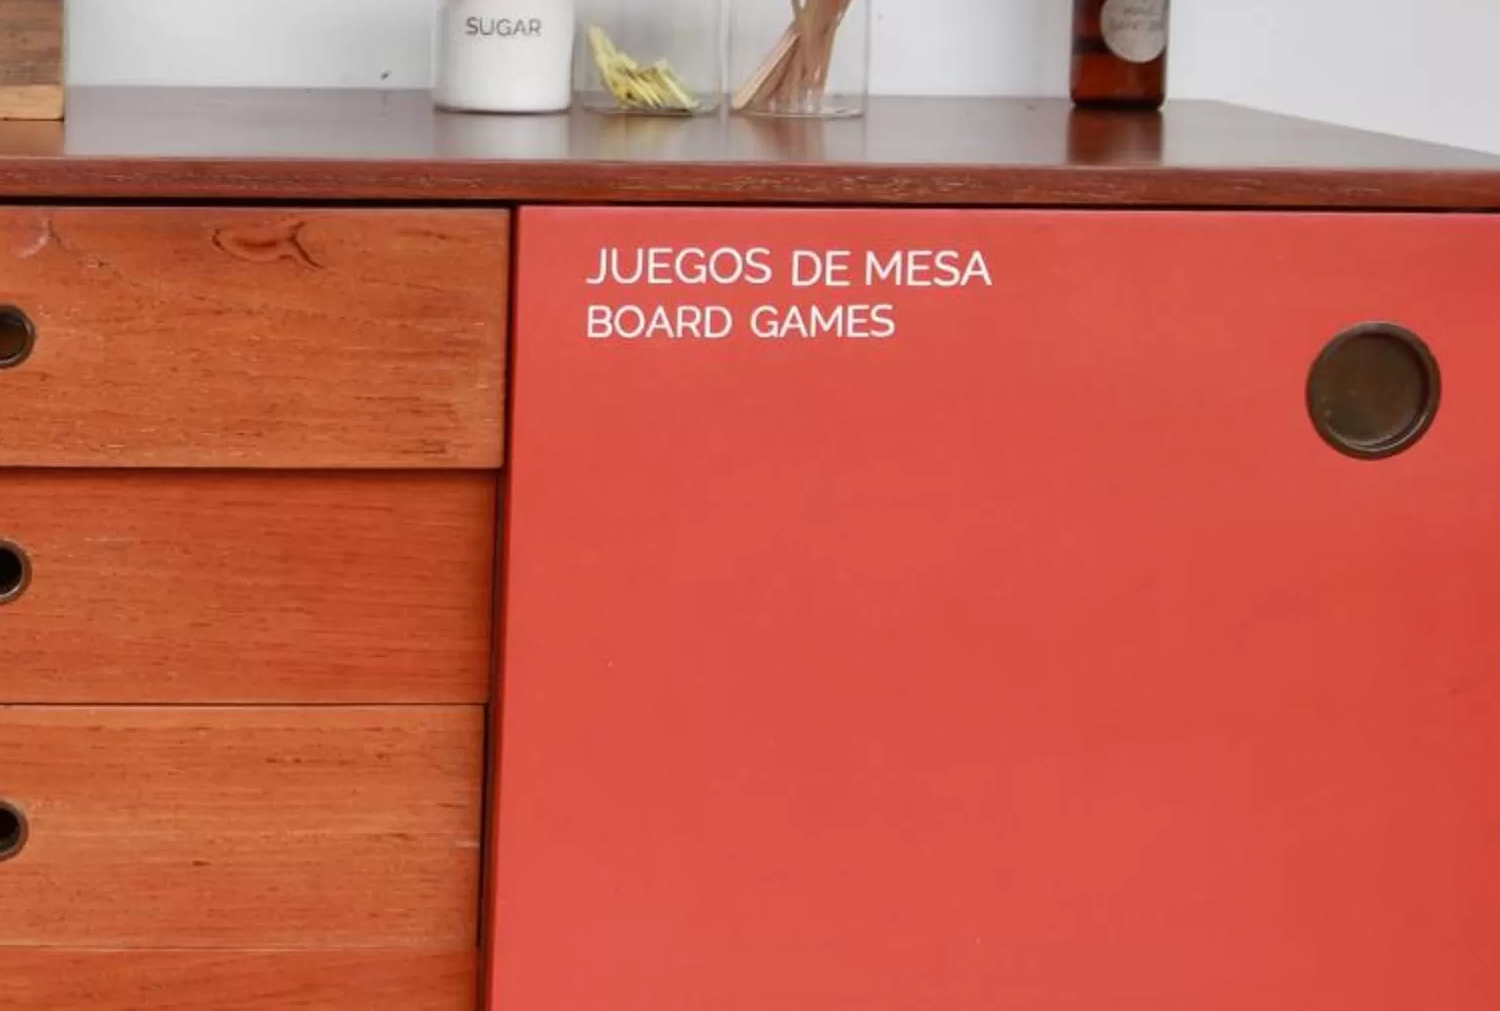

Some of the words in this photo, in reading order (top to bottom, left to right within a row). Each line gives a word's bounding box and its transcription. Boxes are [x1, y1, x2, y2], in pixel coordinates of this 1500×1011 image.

[464, 16, 543, 37] SUGAR
[585, 246, 773, 285] JUEGOS
[791, 249, 852, 287] DE
[865, 249, 993, 287] MESA
[587, 304, 733, 339] BOARD
[749, 303, 896, 338] GAMES
